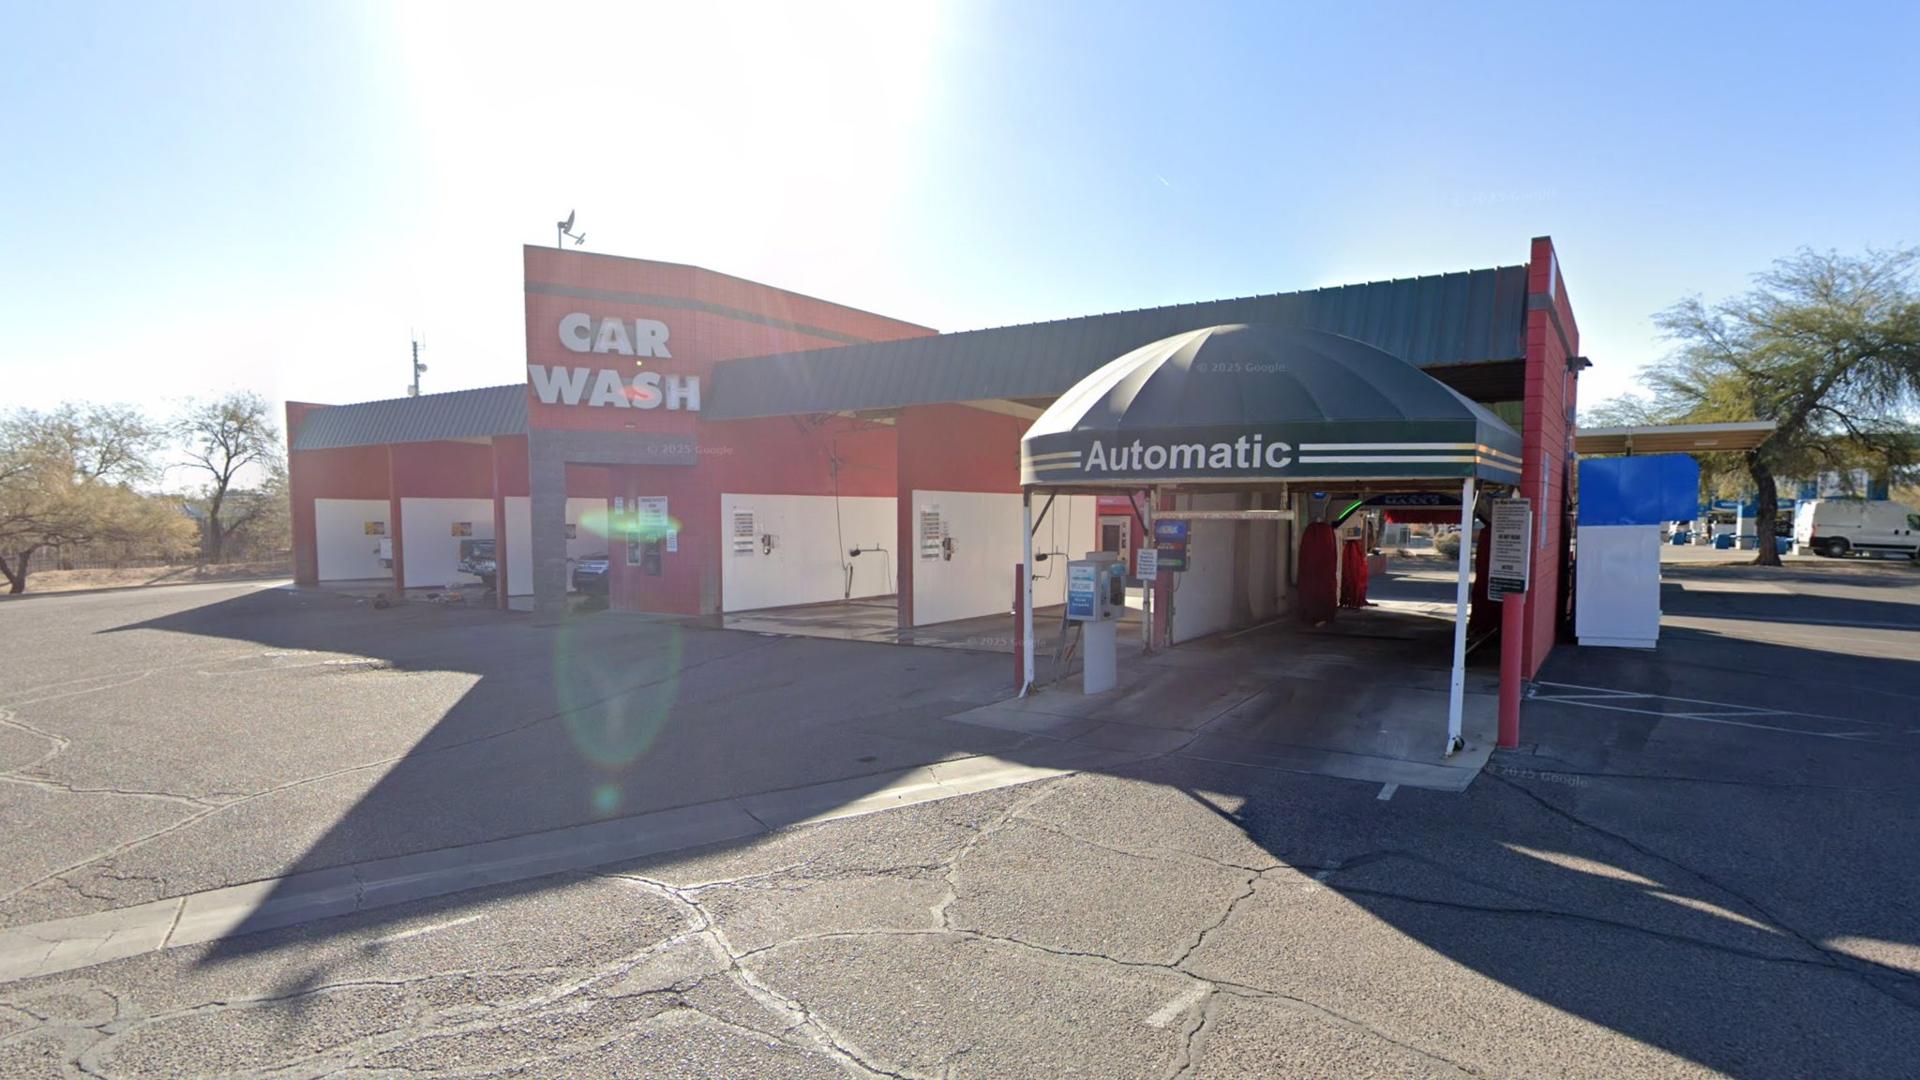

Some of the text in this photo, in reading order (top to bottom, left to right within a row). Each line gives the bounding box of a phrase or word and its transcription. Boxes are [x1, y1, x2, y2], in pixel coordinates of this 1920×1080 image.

[558, 312, 673, 358] CAR
[527, 364, 701, 411] WASH
[1083, 433, 1293, 473] Automatic
